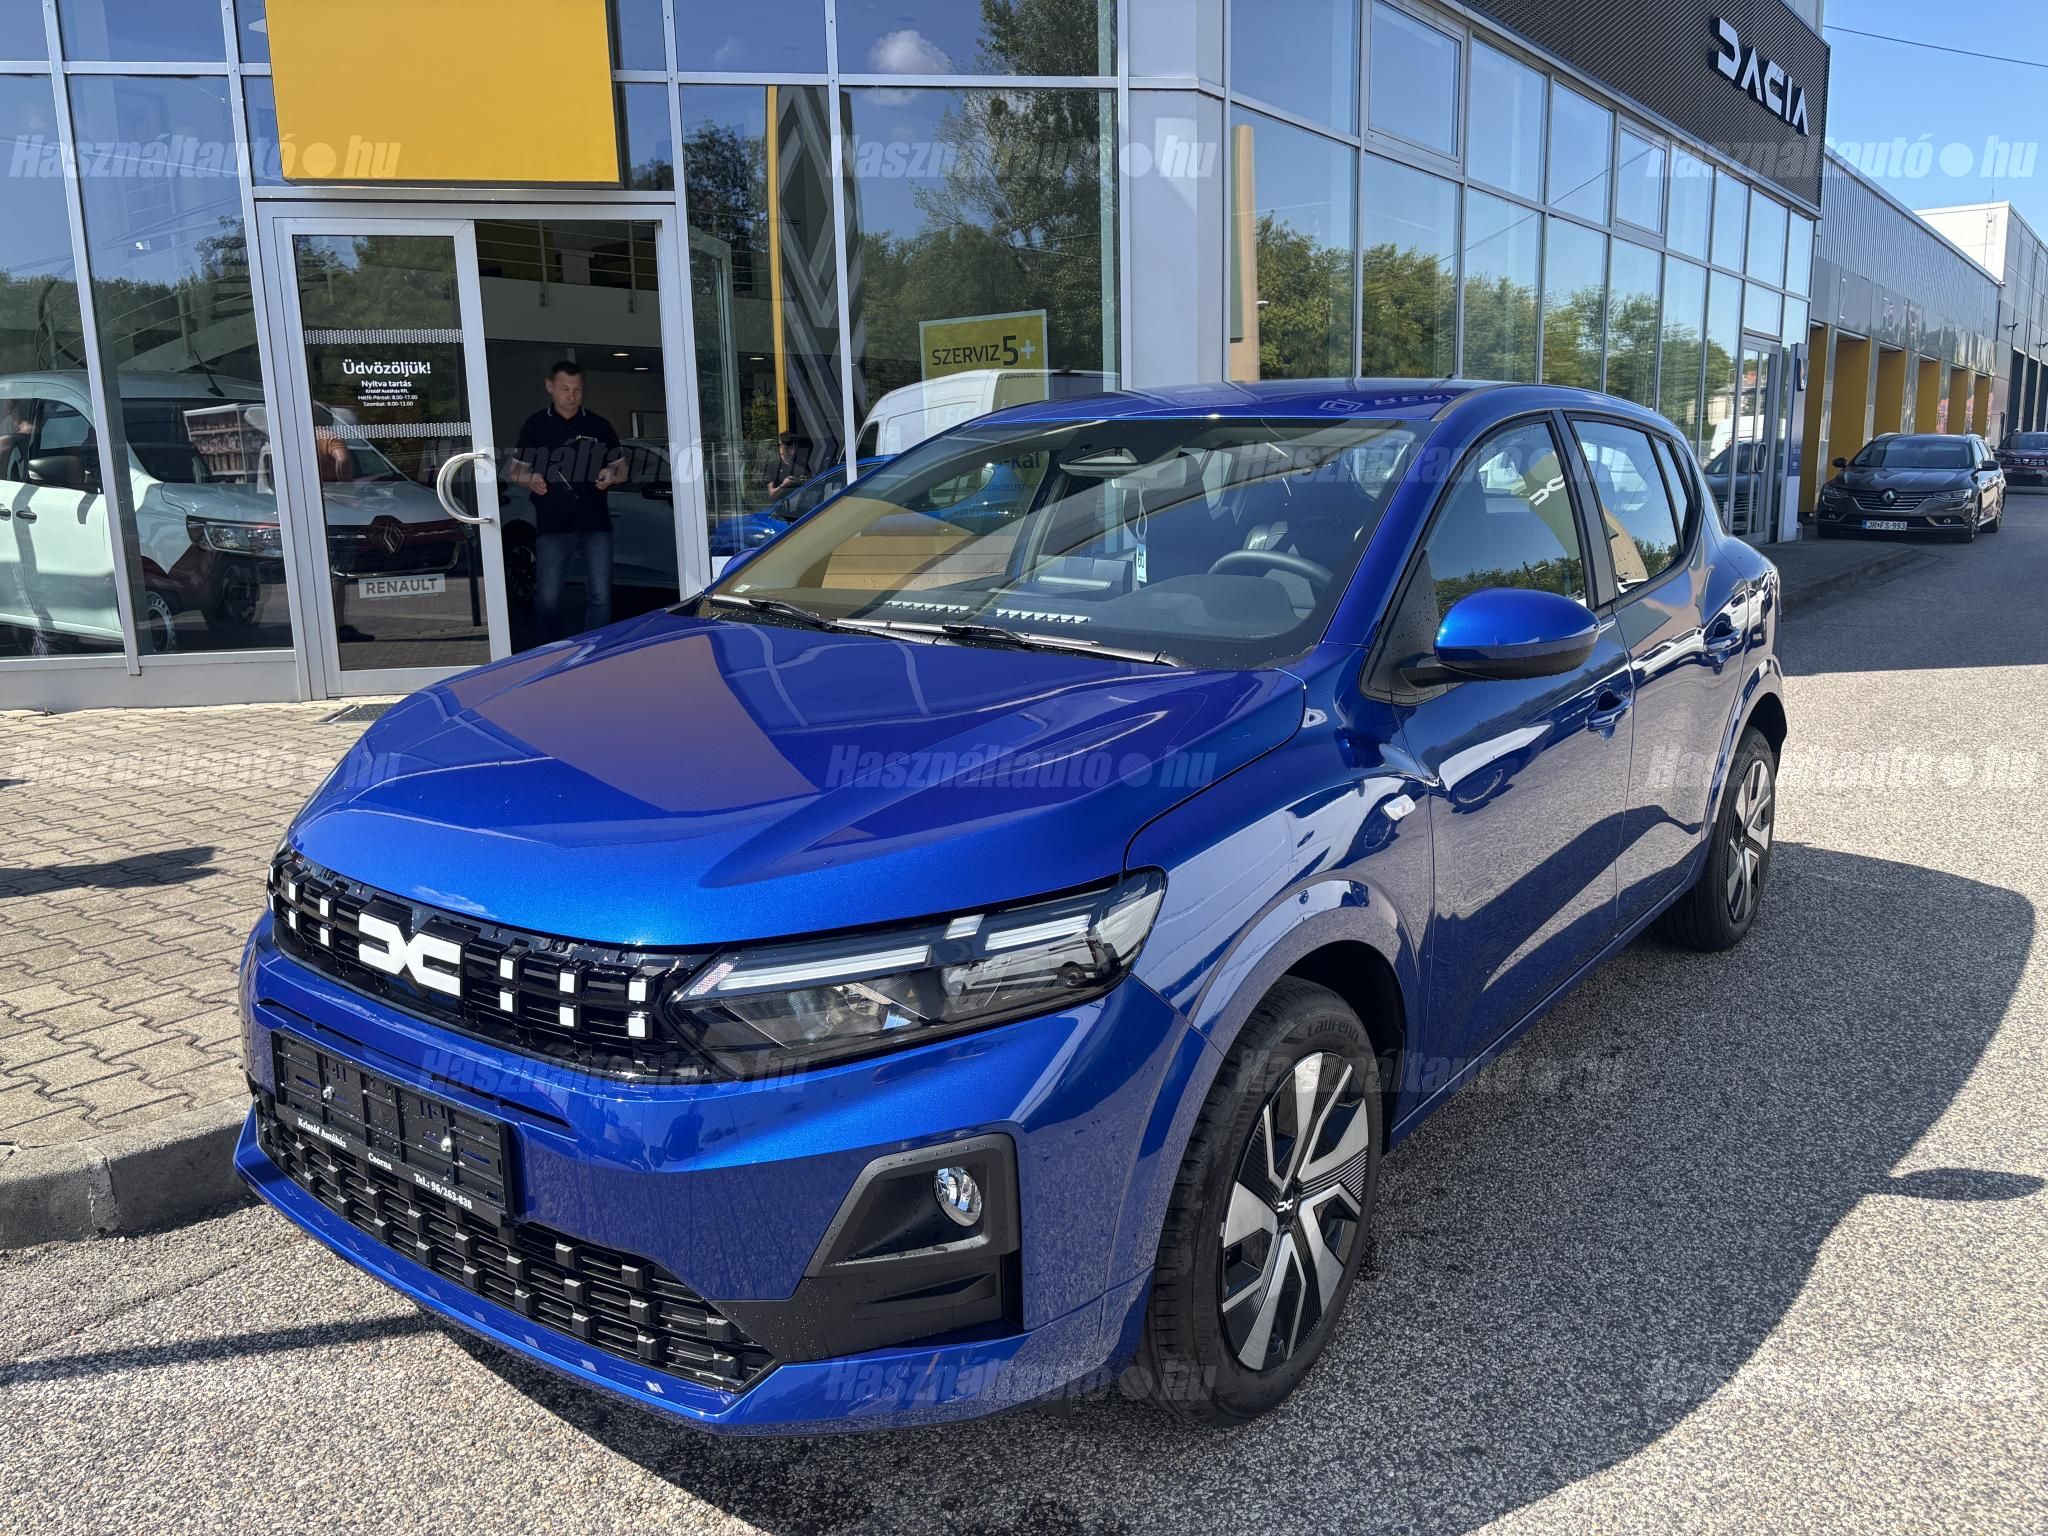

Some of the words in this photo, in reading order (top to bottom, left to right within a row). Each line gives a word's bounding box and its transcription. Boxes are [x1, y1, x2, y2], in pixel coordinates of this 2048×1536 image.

[1716, 16, 1809, 136] DACIA
[932, 344, 1001, 366] SZERVIZ
[342, 359, 432, 377] Üdvözöljük!
[361, 380, 387, 389] Nyitva
[388, 380, 413, 388] tartás
[366, 578, 438, 594] RENAULT
[297, 1117, 320, 1135] Kristóf
[321, 1128, 347, 1149] Autóház
[367, 1152, 393, 1171] Csorna
[413, 1173, 430, 1188] Tel.:
[430, 1181, 473, 1210] 96/263-838
